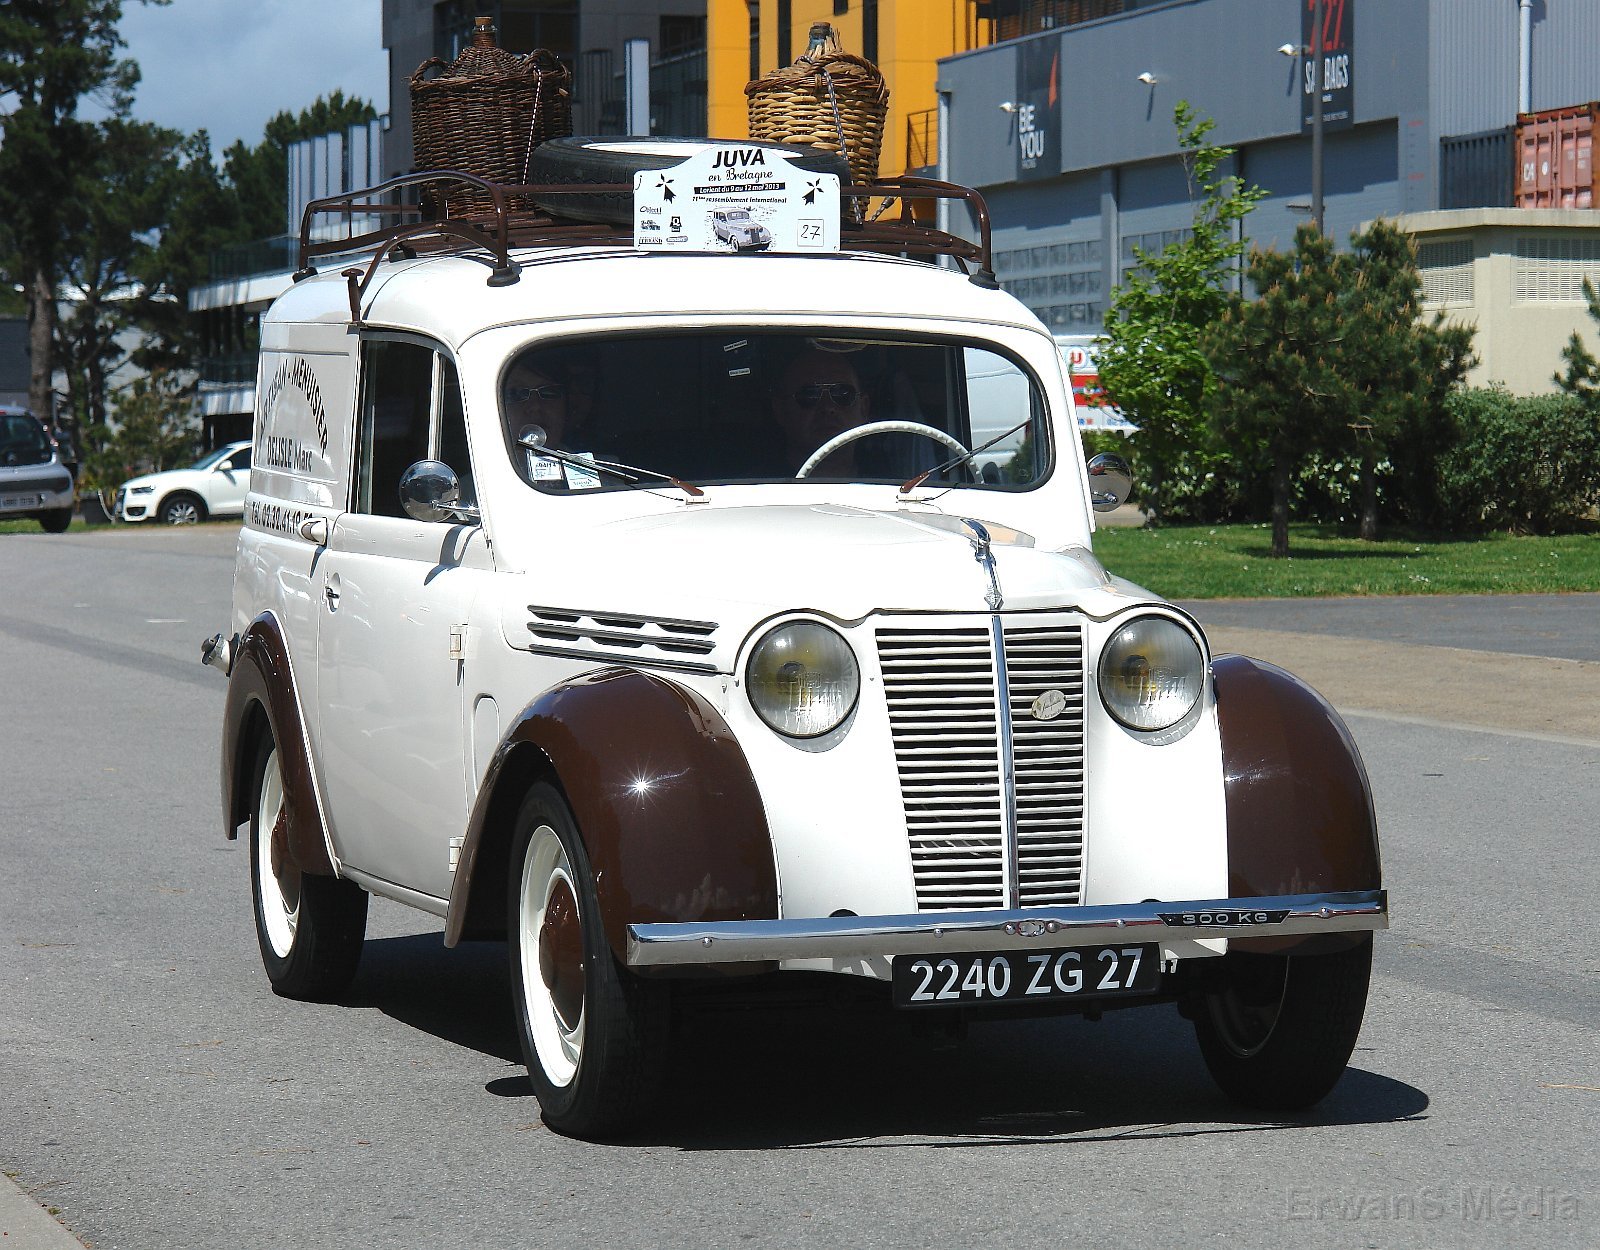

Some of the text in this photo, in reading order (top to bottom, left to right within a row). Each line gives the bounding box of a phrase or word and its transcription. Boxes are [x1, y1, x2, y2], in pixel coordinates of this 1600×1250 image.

[1019, 105, 1035, 133] BE
[1019, 130, 1044, 159] YOU
[712, 149, 765, 168] JUVA
[708, 167, 773, 183] en Bretagne
[699, 186, 721, 194] Lorient
[721, 185, 730, 193] du
[800, 224, 821, 240] 27
[291, 356, 329, 458] MENUISIER
[267, 436, 313, 472] DELISLE Marc
[1182, 910, 1269, 925] 300 KG
[909, 947, 1144, 1002] 2240 ZG 27
